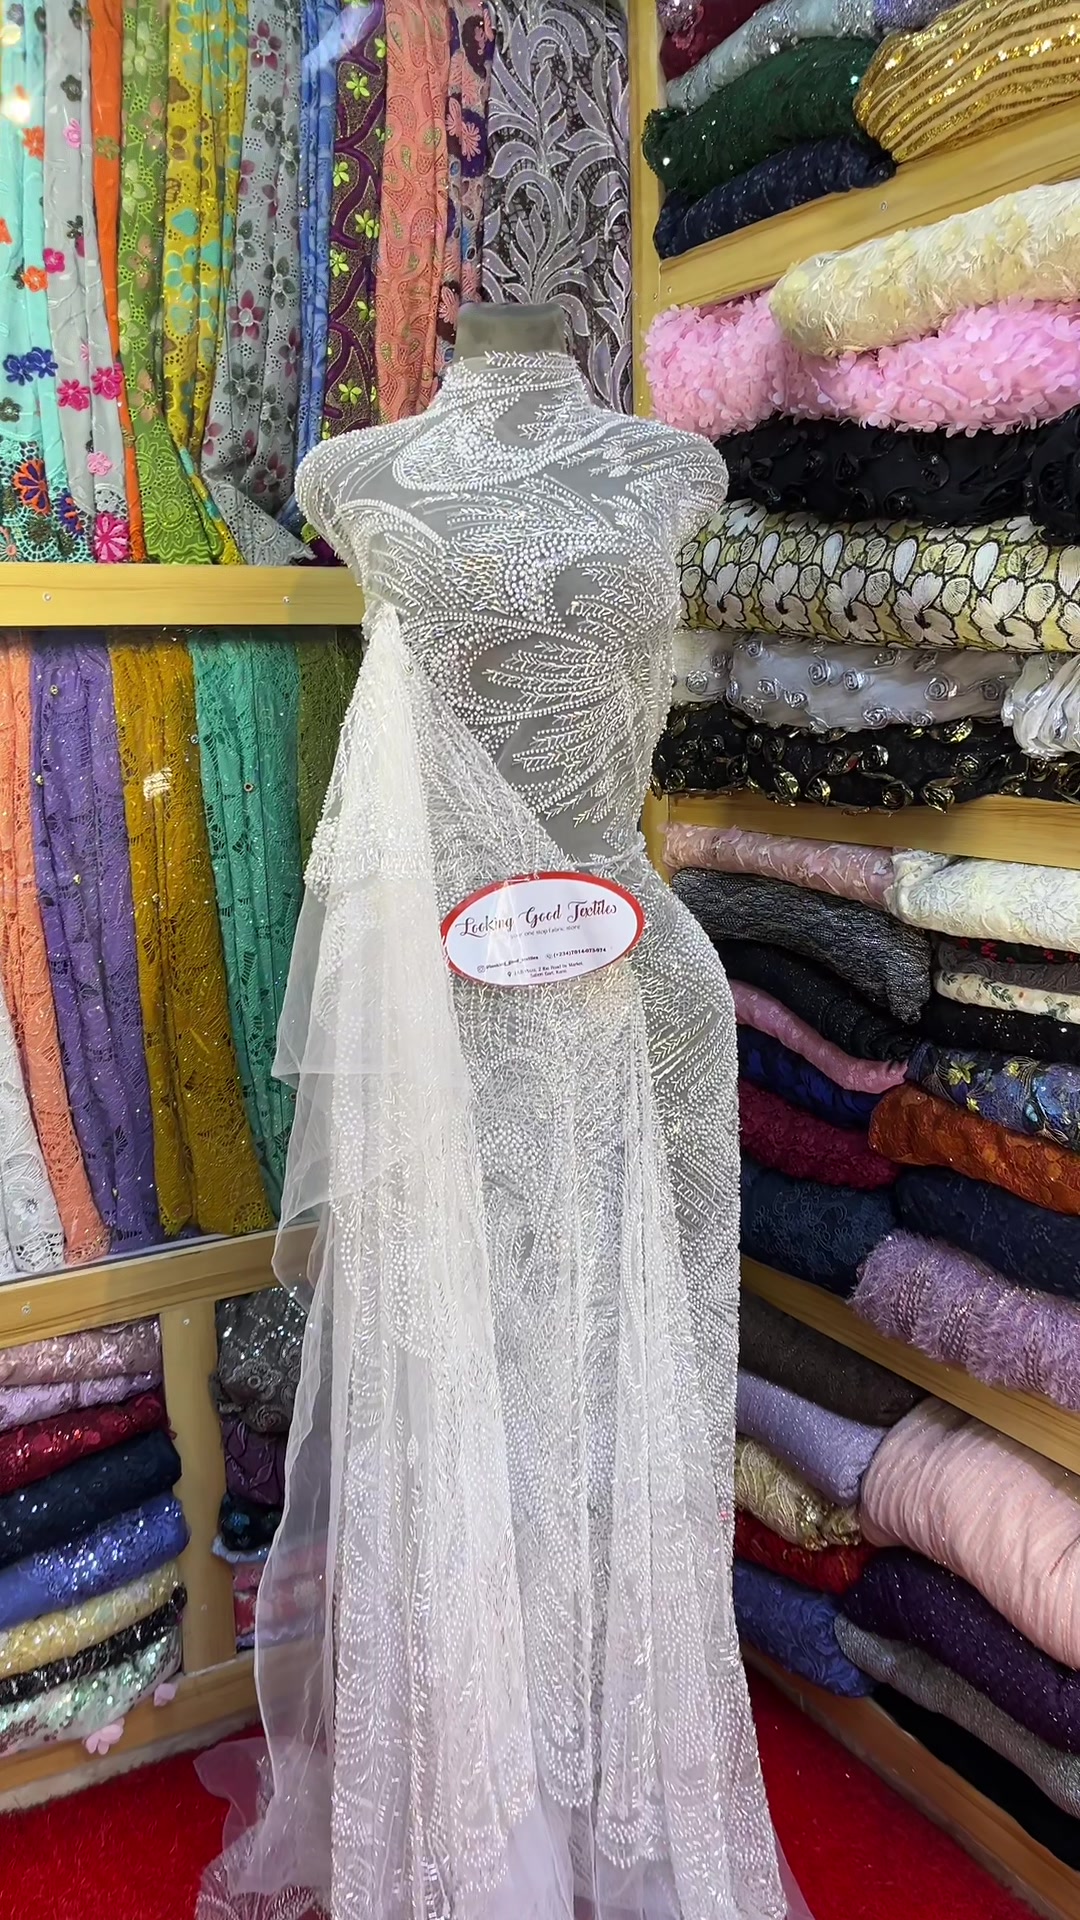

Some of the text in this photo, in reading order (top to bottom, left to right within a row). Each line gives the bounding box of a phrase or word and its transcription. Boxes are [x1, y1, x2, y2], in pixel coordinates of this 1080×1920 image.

[455, 899, 617, 938] Looking Good Textiles
[536, 928, 548, 936] stop
